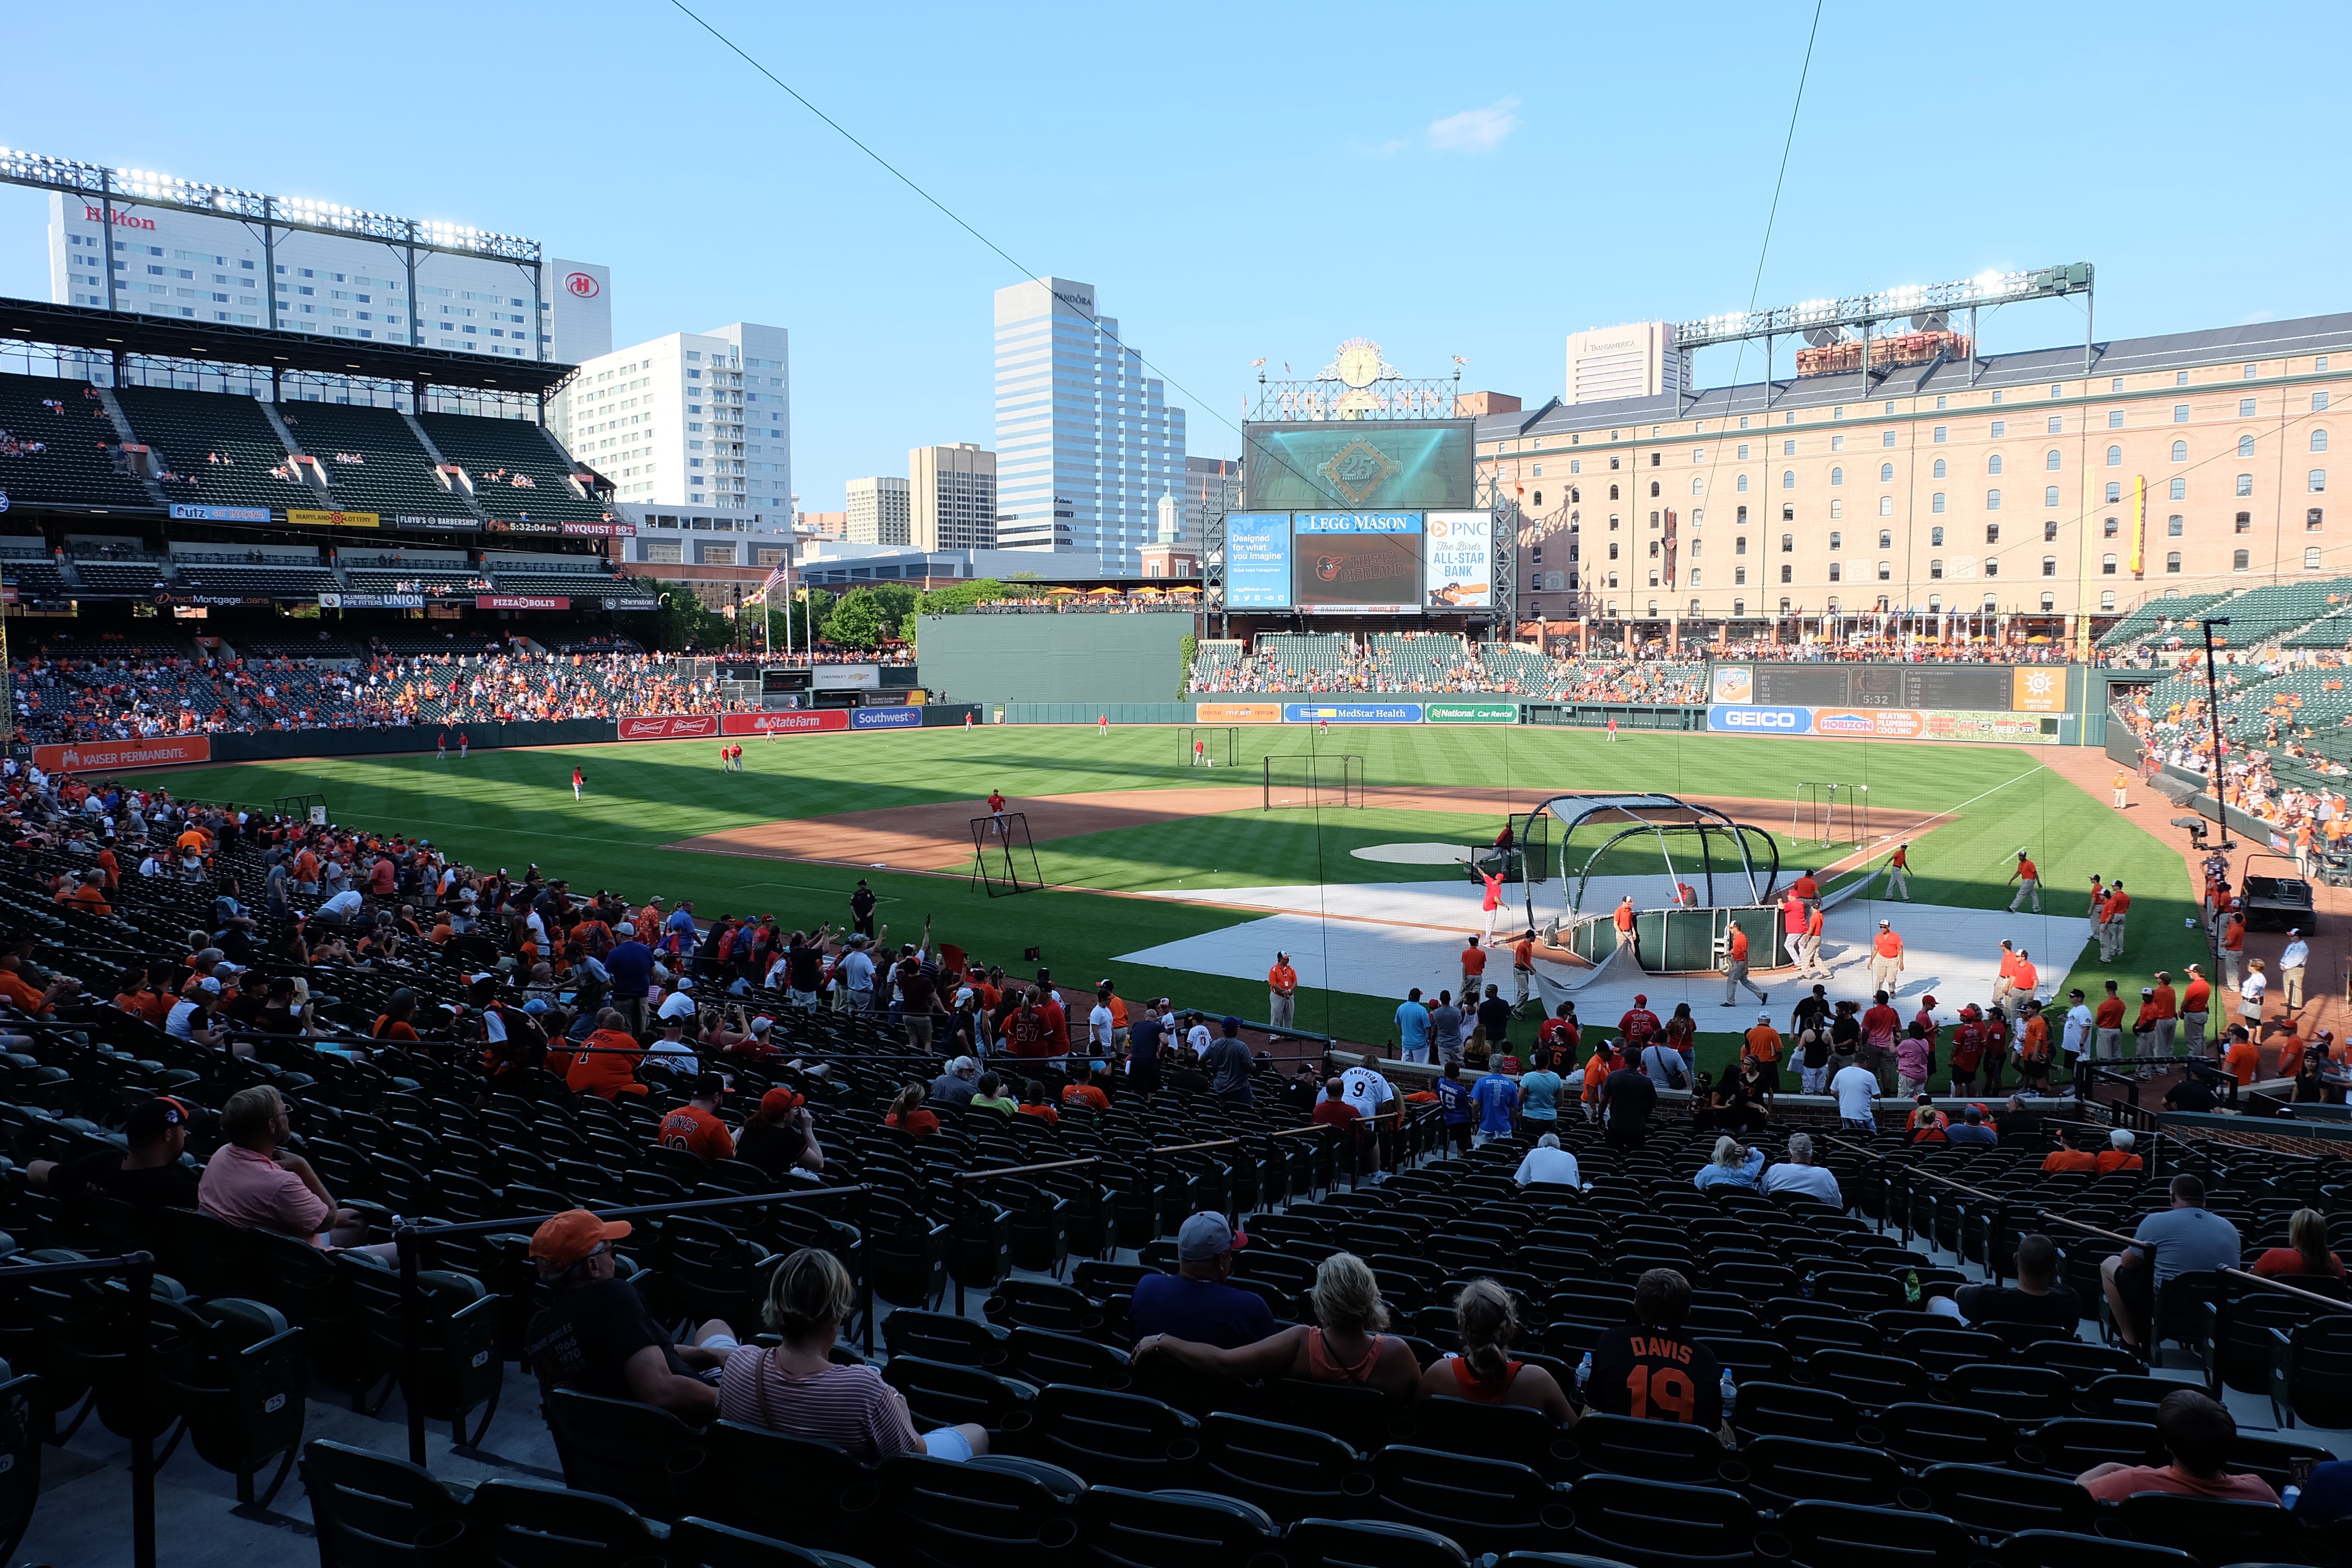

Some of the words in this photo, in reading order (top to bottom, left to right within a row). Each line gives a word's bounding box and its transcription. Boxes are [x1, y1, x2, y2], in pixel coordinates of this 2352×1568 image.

[85, 206, 156, 230] Hlton
[1337, 337, 1381, 355] ORIOLES
[1278, 392, 1324, 411] THE
[1396, 391, 1441, 409] SUN
[1343, 455, 1373, 477] 25
[438, 517, 478, 526] BARBERSHOP
[510, 523, 546, 531] 5:32:04
[1310, 515, 1350, 530] LEGG
[1353, 515, 1407, 529] MASON
[565, 524, 610, 534] NYQUIST
[1450, 522, 1488, 536] PNC
[1233, 534, 1270, 544] Designed
[1436, 541, 1454, 551] The
[1456, 541, 1482, 551] Birds
[1349, 554, 1378, 567] THIS
[1382, 551, 1394, 564] IS
[1433, 552, 1484, 564] ALL-STAR
[1445, 565, 1472, 576] BANK
[155, 592, 269, 605] DirectMortgageLoans
[384, 595, 423, 605] UNION
[1863, 695, 1888, 704] 5:32
[859, 712, 908, 723] Southwest
[1726, 711, 1795, 727] GEICO
[1877, 720, 1918, 728] PLUMBING
[1822, 721, 1873, 730] HORIZON
[84, 753, 117, 765] KAISER
[121, 748, 184, 762] PERMANENTE
[1017, 1023, 1039, 1041] 27
[1553, 1052, 1562, 1065] 6
[1350, 1069, 1378, 1084] ANDERSON
[1352, 1081, 1365, 1097] 9
[1439, 1090, 1456, 1109] 19
[664, 1115, 698, 1134] JONES
[555, 1336, 577, 1354] 1966
[1630, 1336, 1692, 1364] DAVIS
[475, 1353, 485, 1365] 24
[1627, 1365, 1694, 1422] 19
[270, 1396, 282, 1410] 25
